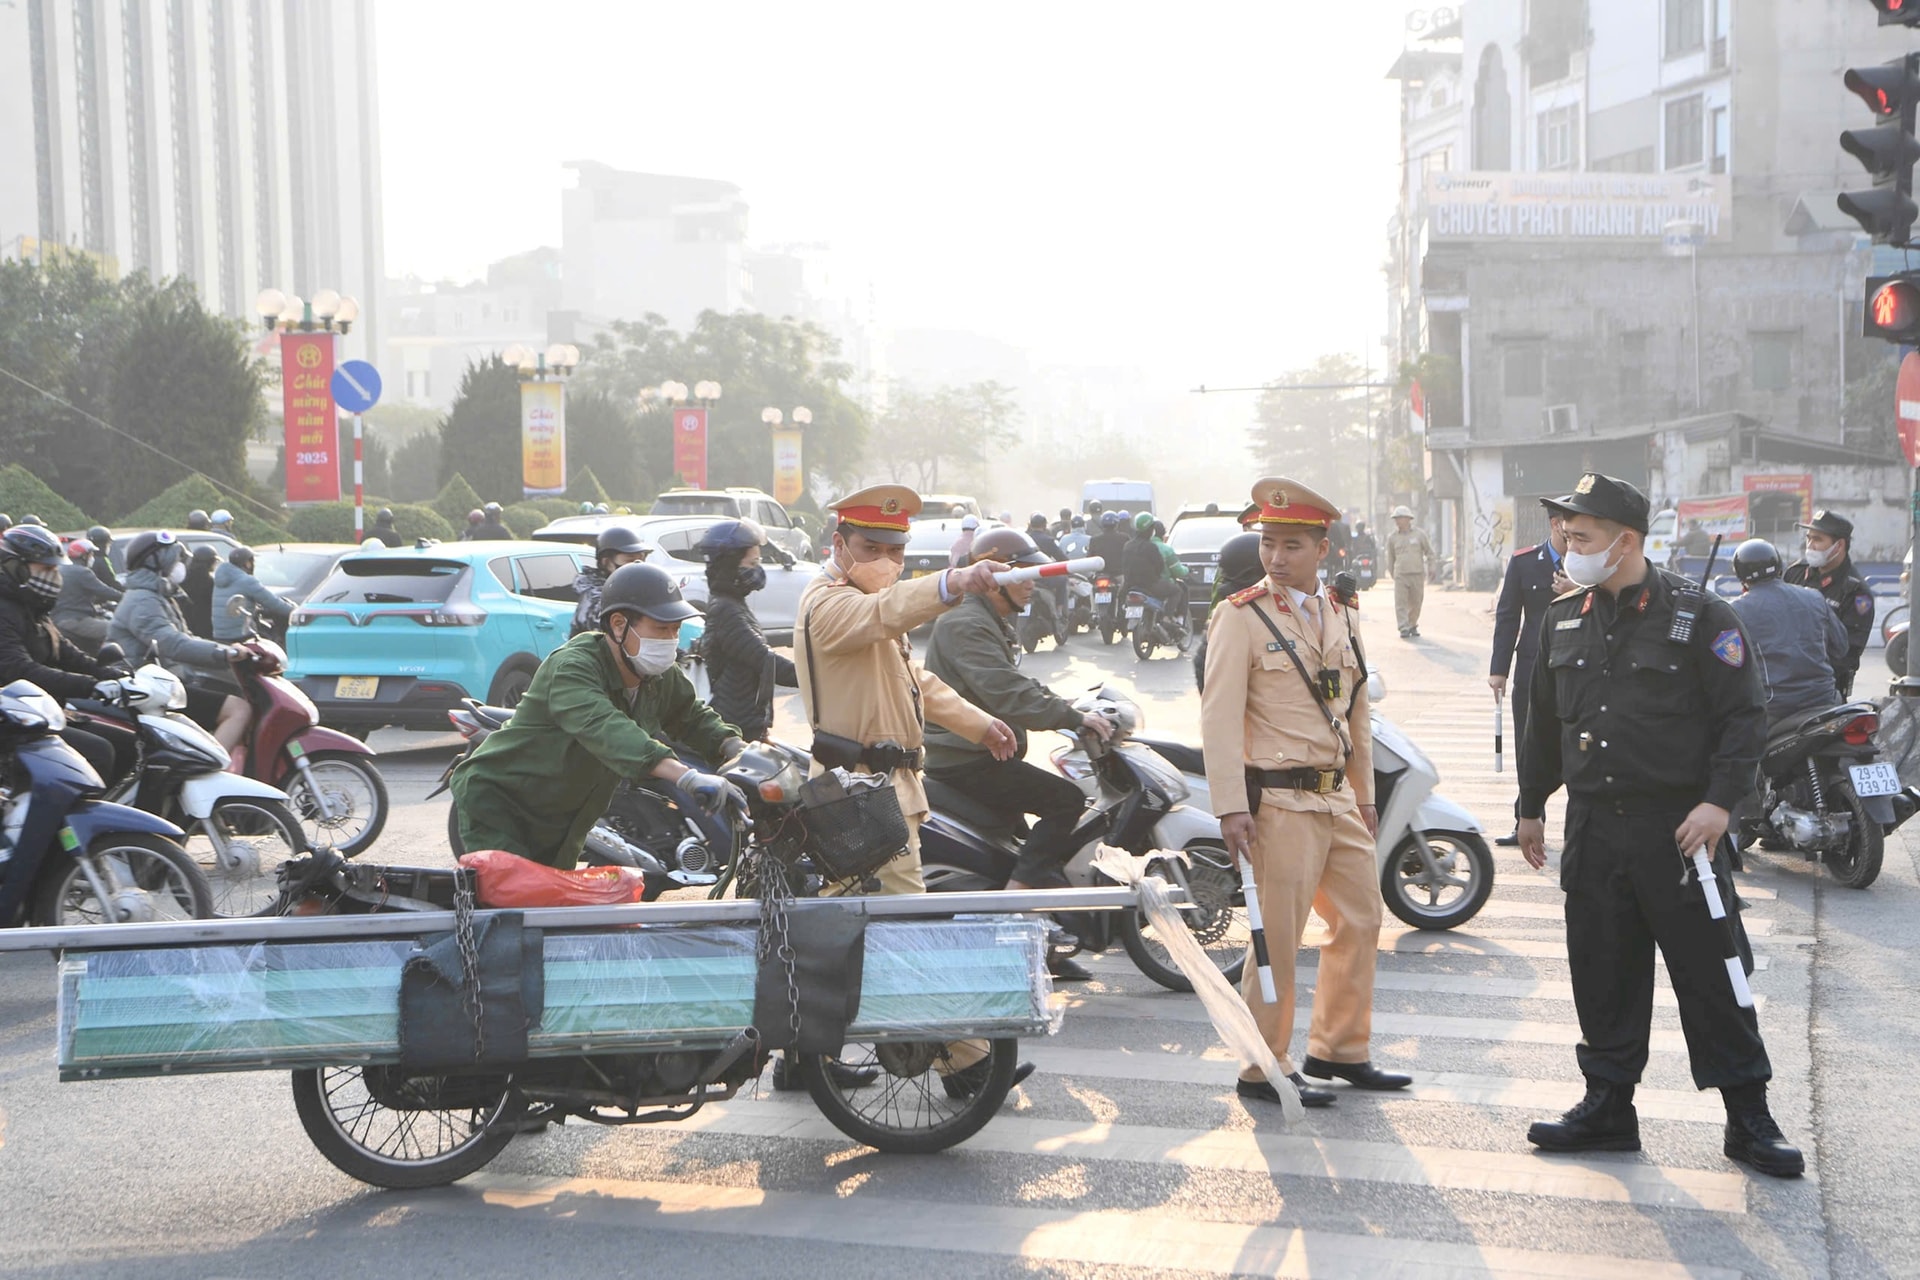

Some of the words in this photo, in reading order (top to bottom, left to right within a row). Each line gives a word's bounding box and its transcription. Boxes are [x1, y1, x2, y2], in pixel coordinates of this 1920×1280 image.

[1437, 191, 1511, 235] CHUYỂN
[1517, 200, 1566, 235] PHÁT
[1571, 203, 1635, 235] NHANH
[293, 374, 326, 390] Chúc
[296, 452, 328, 464] 2025
[1857, 766, 1889, 780] 29-G1
[1857, 779, 1898, 794] 239.29
